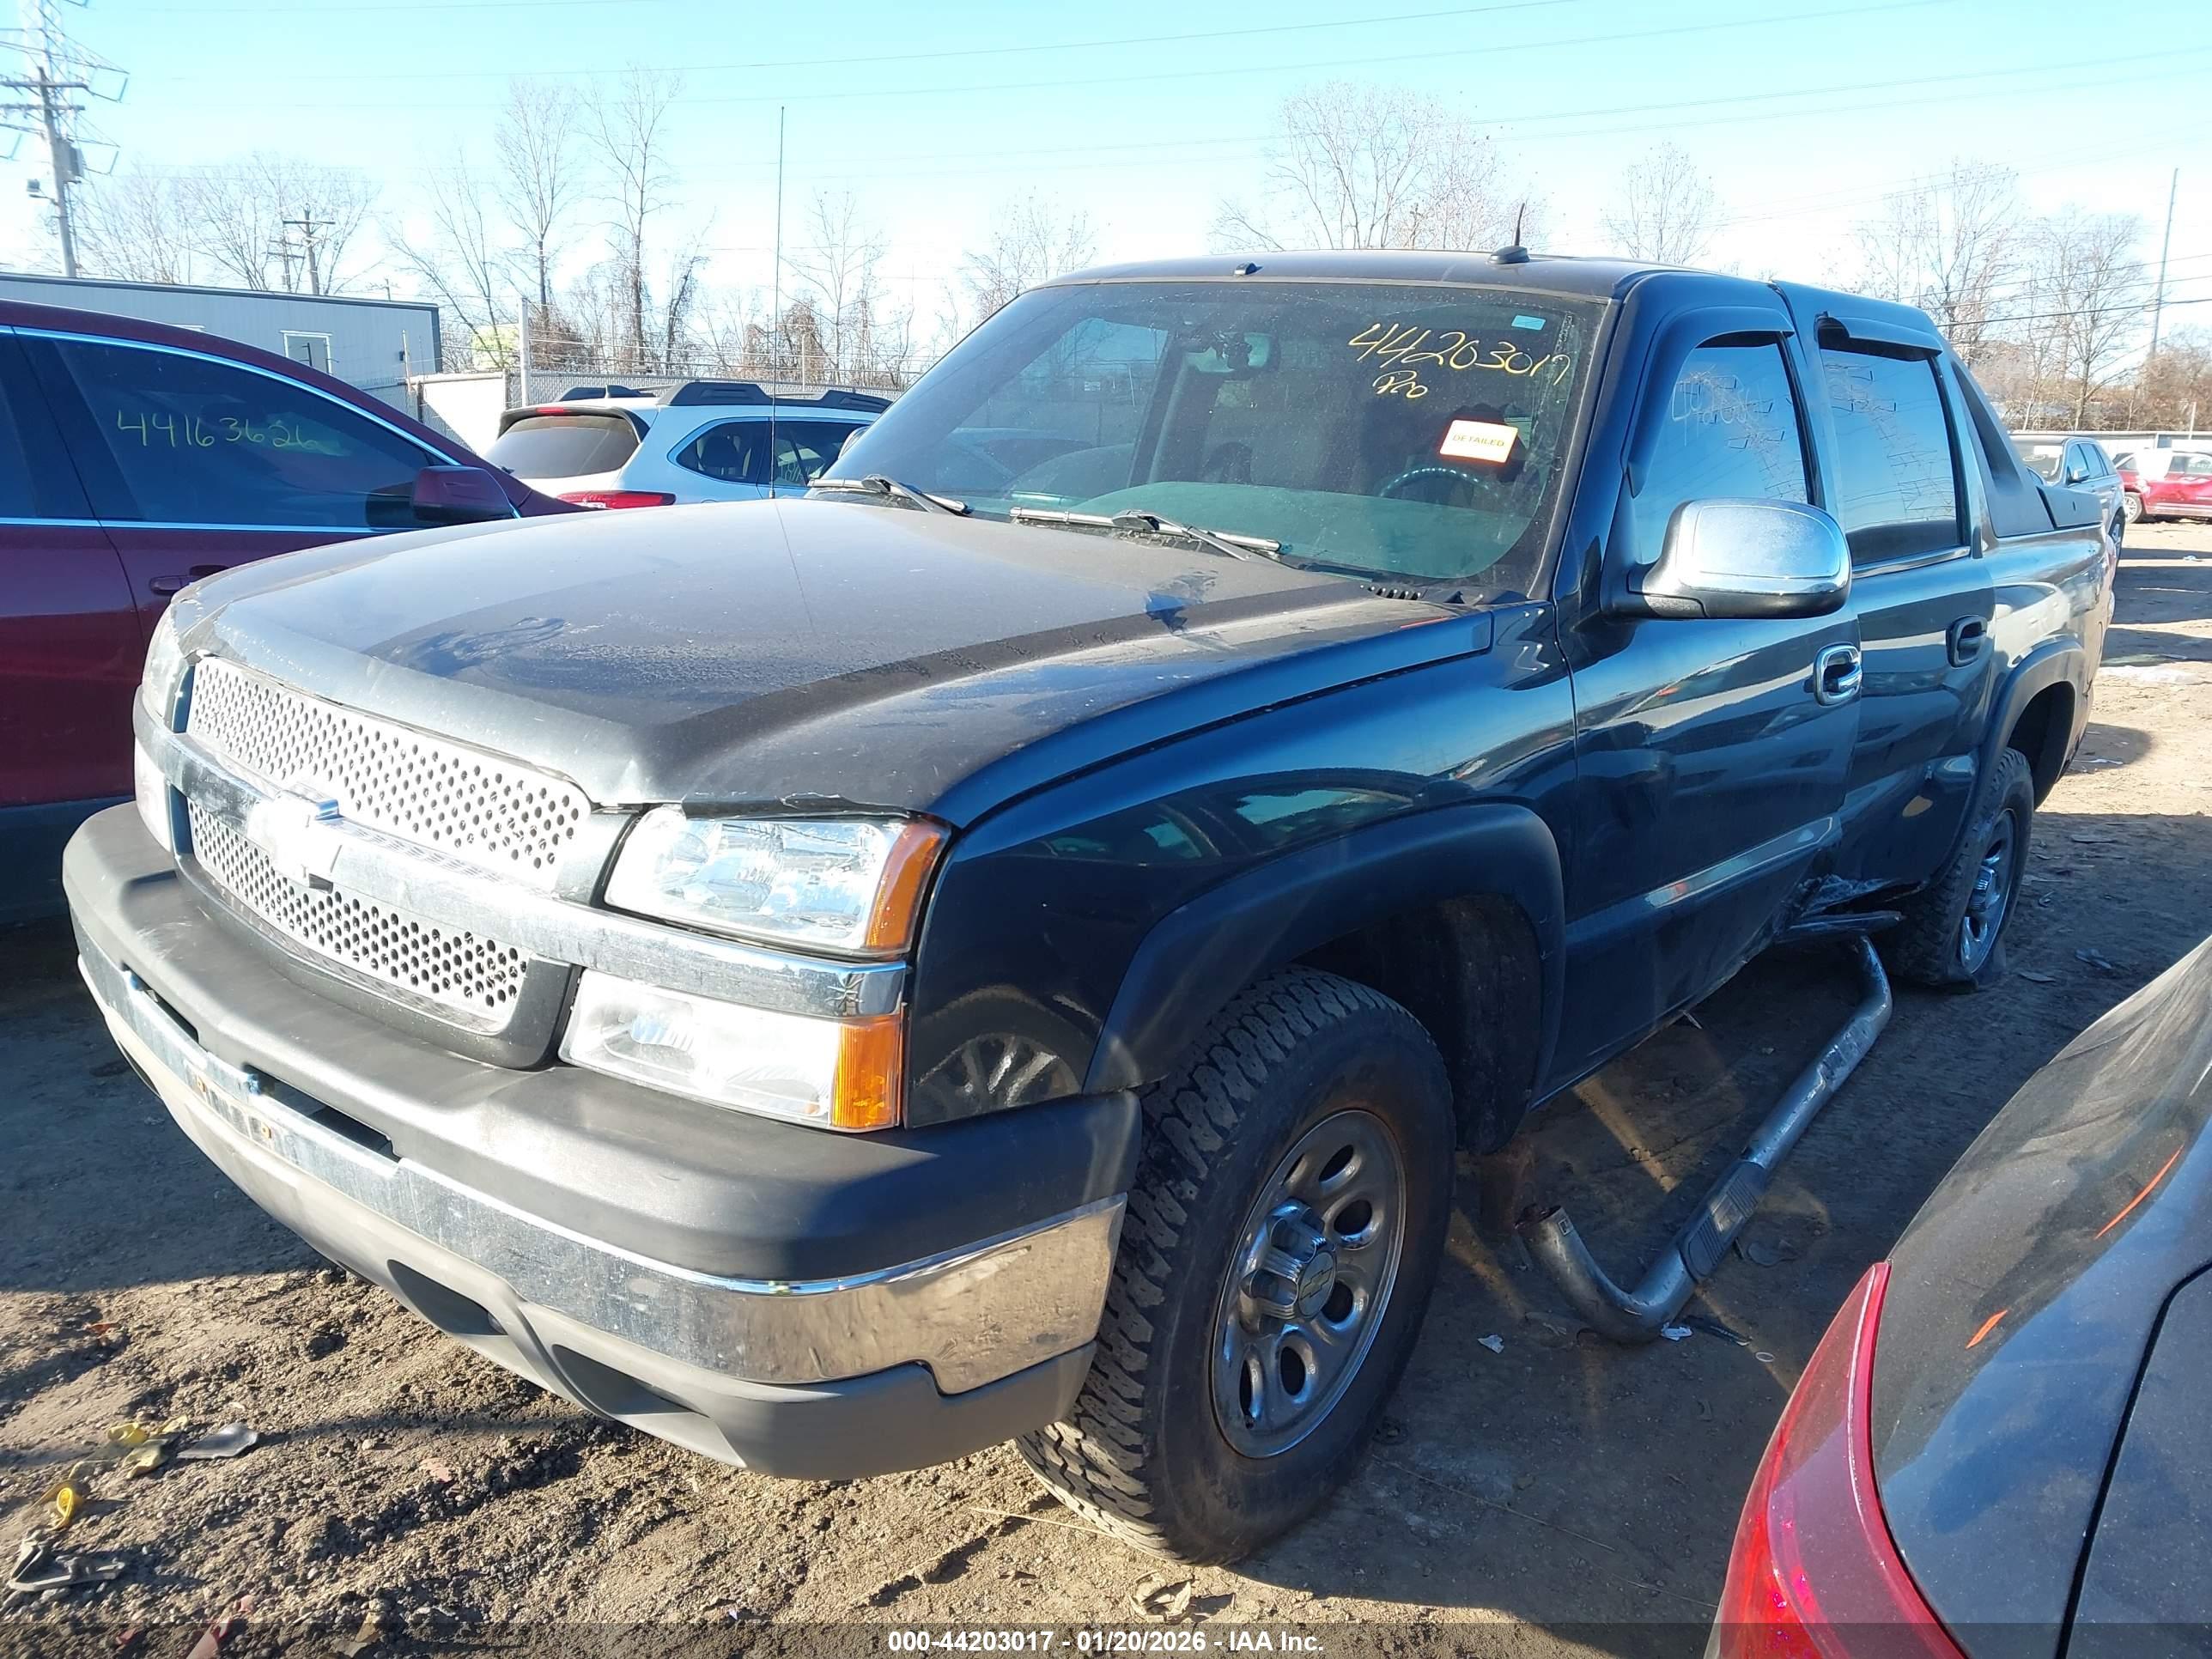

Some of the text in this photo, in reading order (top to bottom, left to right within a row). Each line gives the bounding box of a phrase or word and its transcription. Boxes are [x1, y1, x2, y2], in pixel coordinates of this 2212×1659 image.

[1348, 323, 1571, 386] 44203017
[117, 410, 320, 447] 44163626
[1452, 434, 1504, 447] DETAILED
